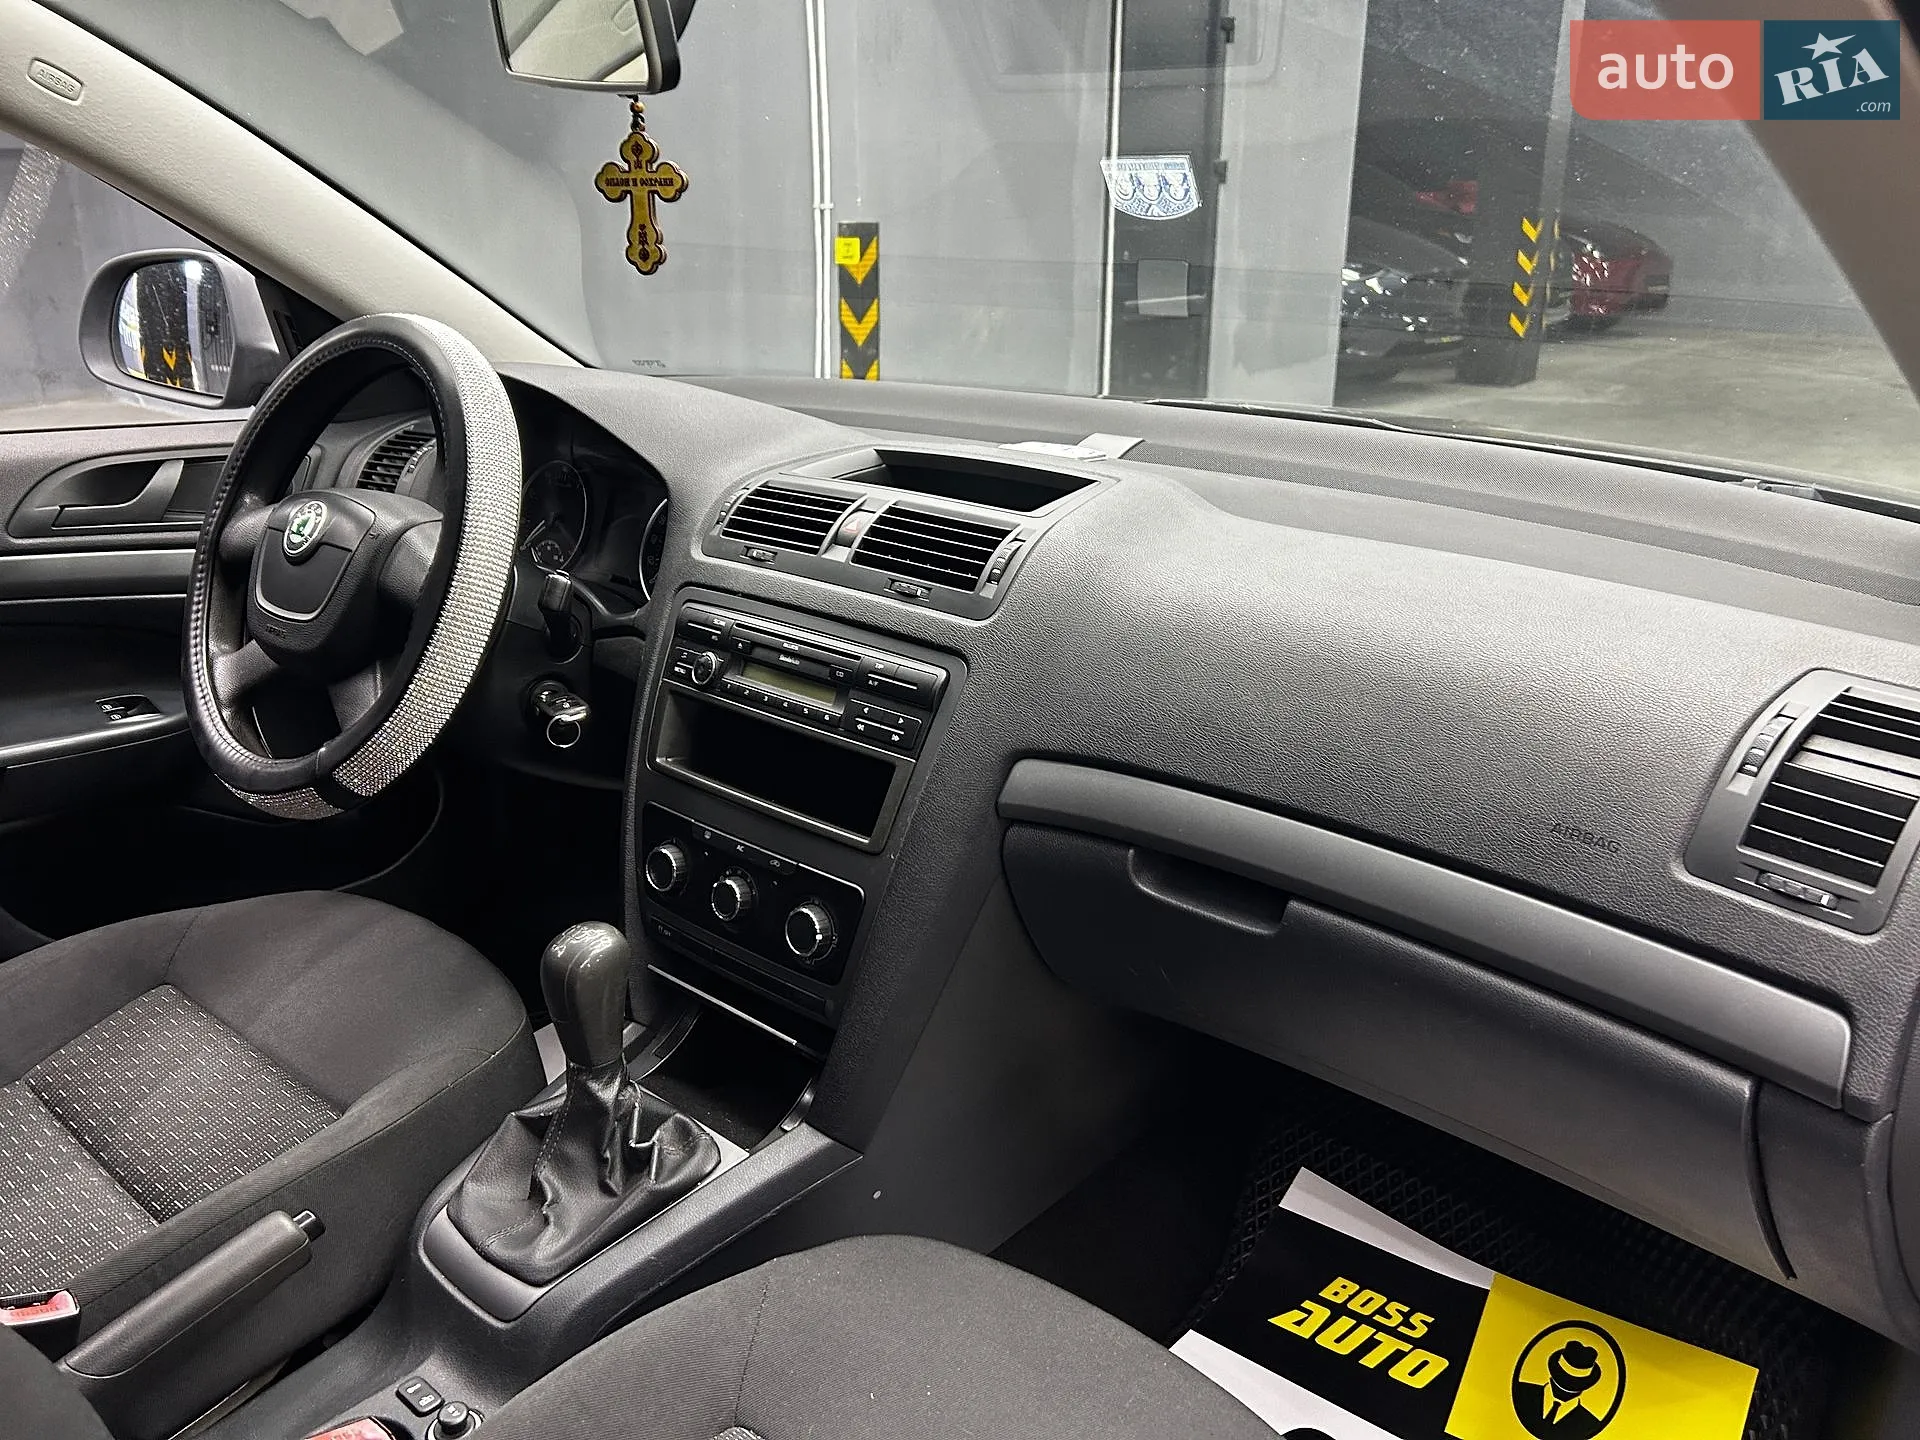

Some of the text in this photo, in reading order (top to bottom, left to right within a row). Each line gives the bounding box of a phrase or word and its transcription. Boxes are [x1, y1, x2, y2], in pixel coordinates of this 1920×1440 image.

[1549, 822, 1621, 854] AIRBAG
[1318, 1276, 1436, 1339] BOSS
[1267, 1300, 1450, 1389] AUTO
